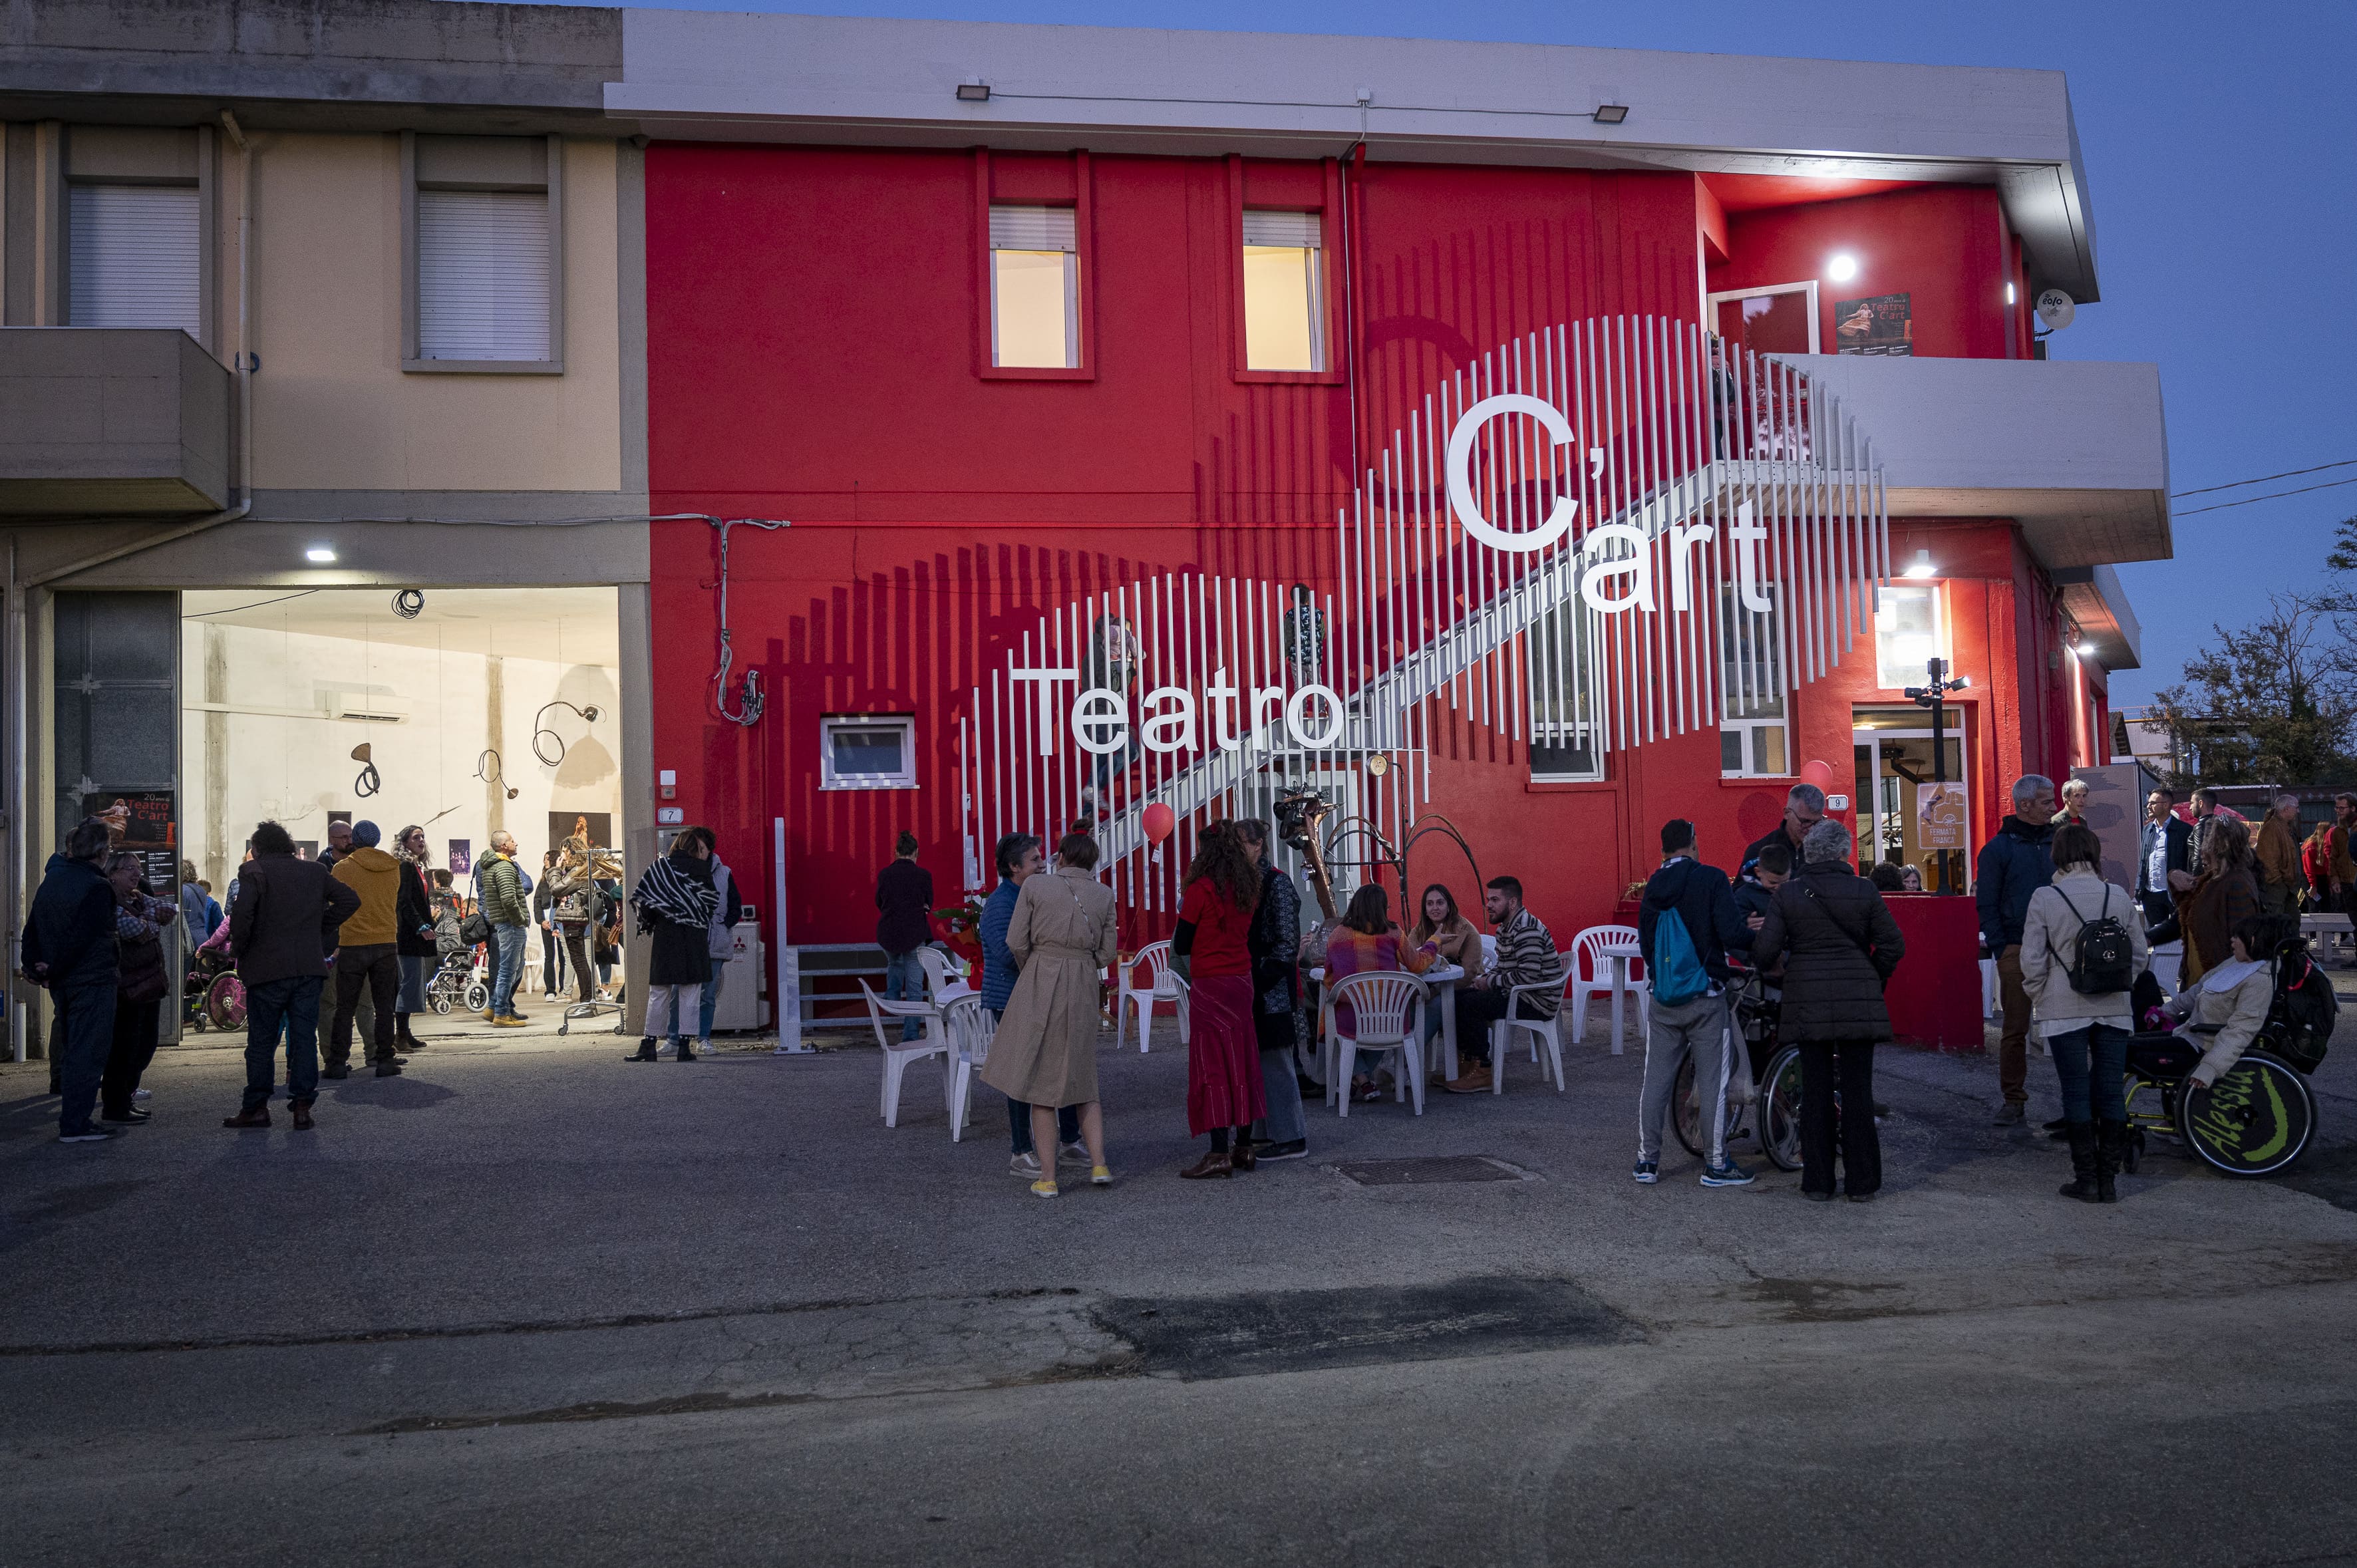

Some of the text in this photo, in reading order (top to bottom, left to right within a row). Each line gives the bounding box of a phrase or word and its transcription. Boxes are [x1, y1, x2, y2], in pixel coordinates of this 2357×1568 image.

[1871, 303, 1906, 311] Teatro
[1879, 311, 1905, 319] C'art
[1446, 393, 1772, 613] C'art
[1010, 666, 1344, 756] Teatro
[127, 799, 170, 810] Teatro
[1835, 798, 1841, 807] 9
[138, 810, 168, 820] C'art
[668, 811, 674, 820] 7
